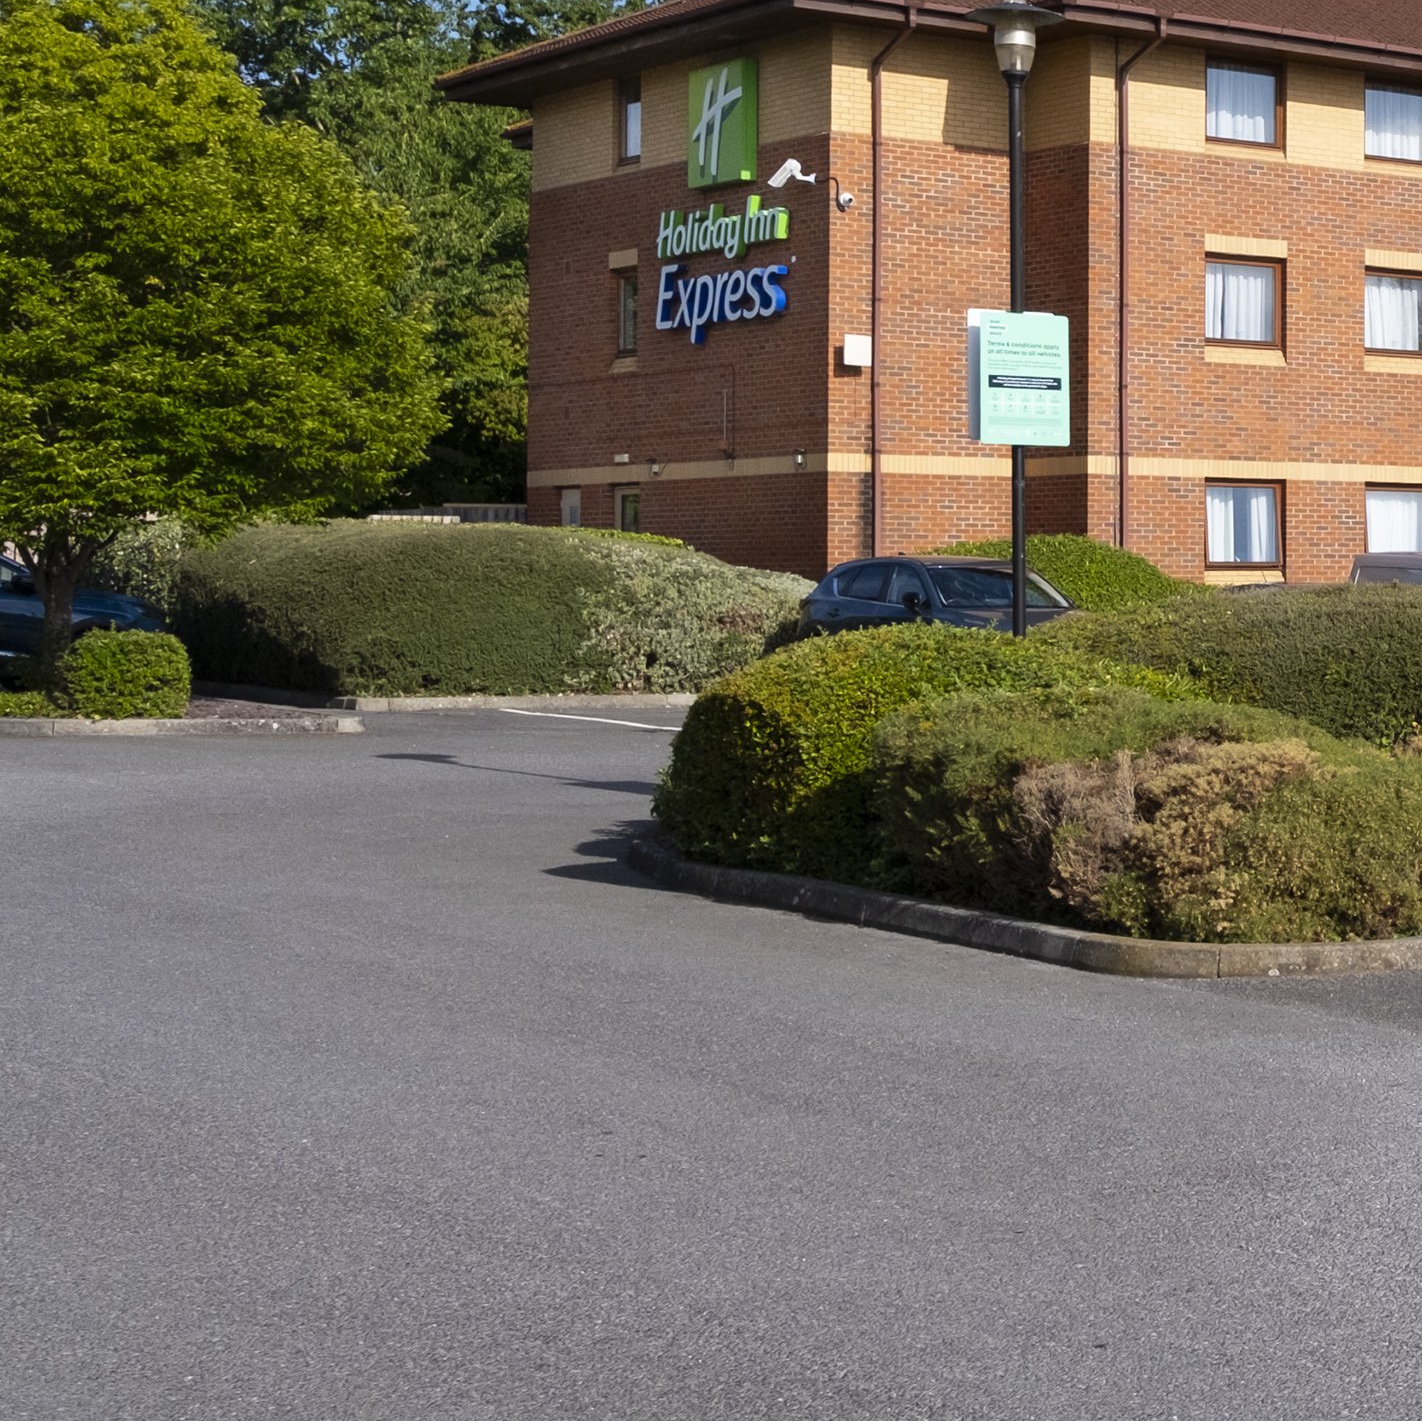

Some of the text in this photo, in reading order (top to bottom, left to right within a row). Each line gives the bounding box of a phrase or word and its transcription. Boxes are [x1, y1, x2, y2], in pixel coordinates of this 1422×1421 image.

[656, 195, 784, 259] Holiday Inn
[656, 264, 783, 344] Express
[1011, 341, 1042, 349] conditions
